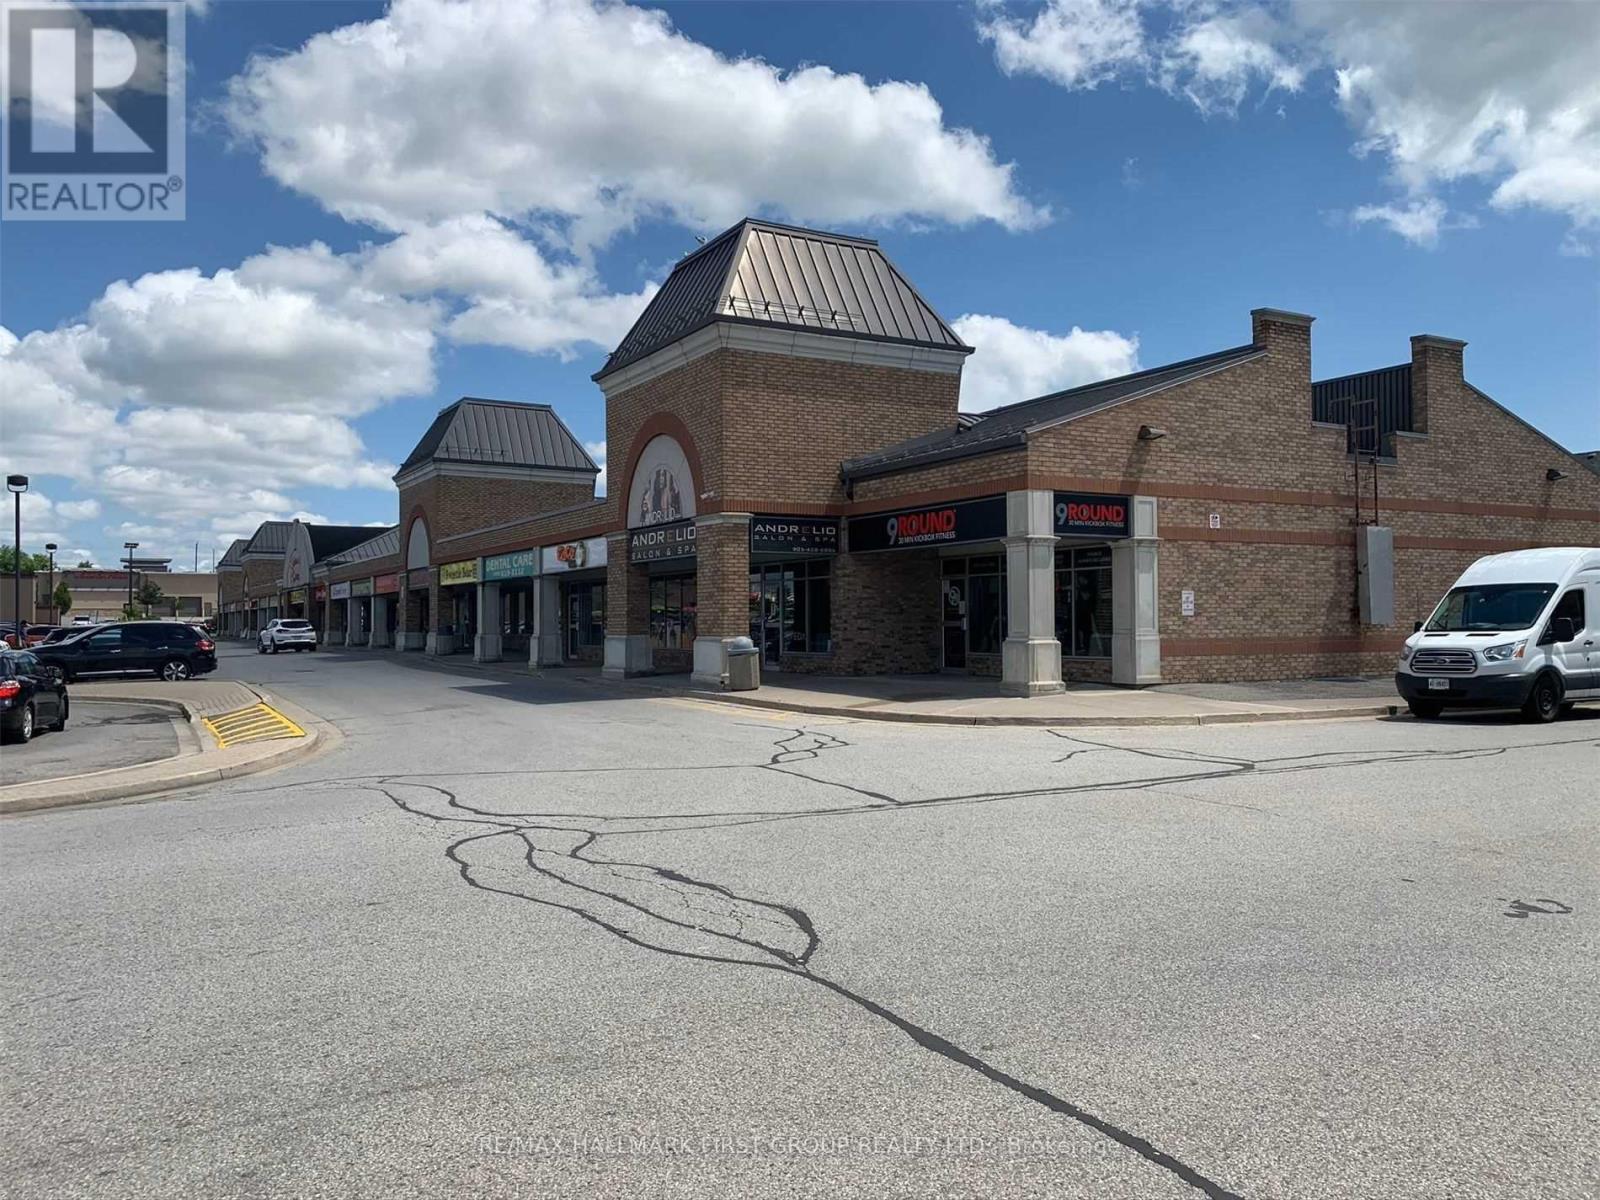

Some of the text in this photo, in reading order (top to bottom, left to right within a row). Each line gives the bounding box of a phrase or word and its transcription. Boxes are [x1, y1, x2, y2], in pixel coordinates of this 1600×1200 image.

[1056, 503, 1125, 525] 9ROUND
[887, 509, 956, 545] 9ROUND
[914, 534, 935, 542] KICKBOX
[935, 531, 956, 540] FITNESS
[486, 553, 534, 572] DENTAL CARE
[631, 549, 660, 561] SALON
[677, 545, 696, 555] SPA
